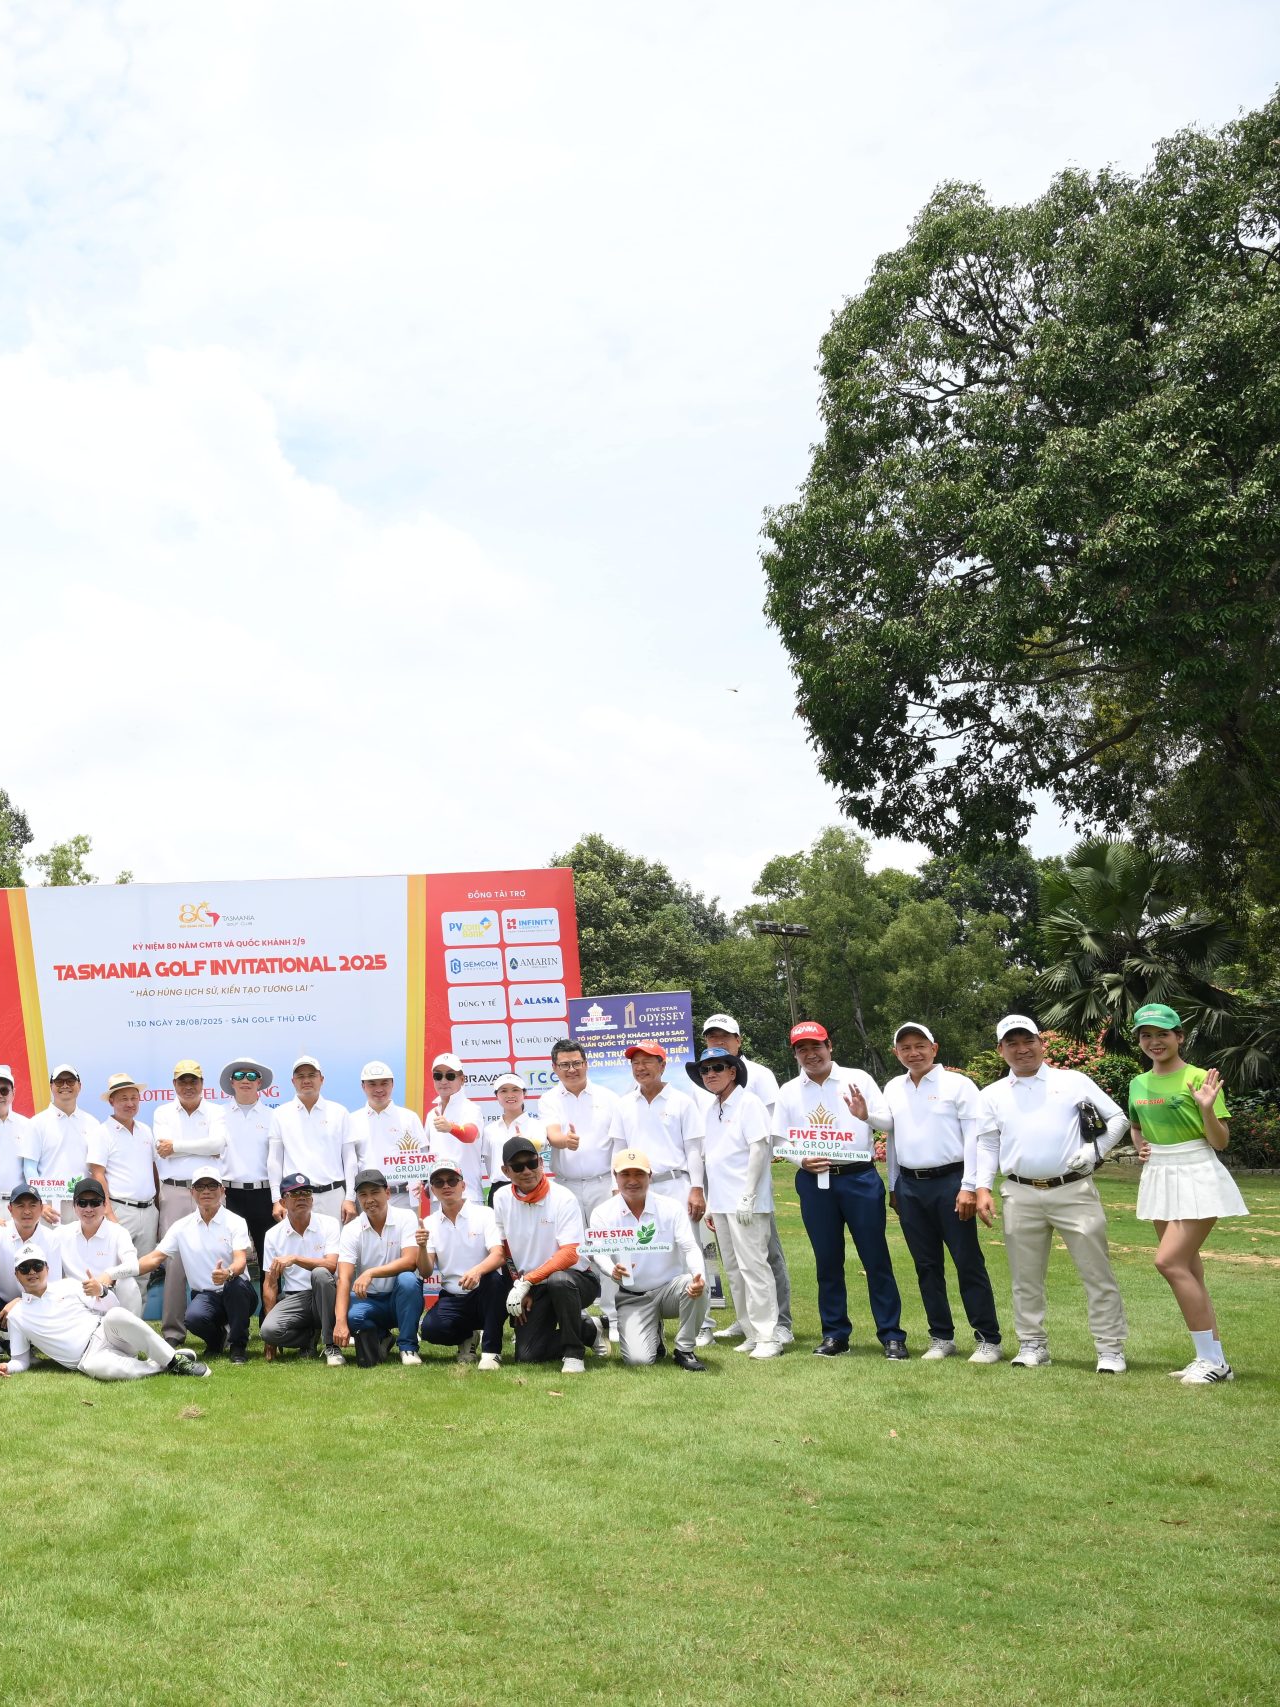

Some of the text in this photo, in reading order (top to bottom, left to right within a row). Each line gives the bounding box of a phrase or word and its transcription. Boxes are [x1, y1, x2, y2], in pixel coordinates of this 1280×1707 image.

[467, 889, 526, 899] ĐỒNG TÀI TRỢ
[518, 918, 554, 926] INFINITY
[145, 941, 165, 952] NIỆM
[178, 941, 198, 949] NĂM
[199, 941, 222, 949] CMT8
[224, 939, 235, 948] VÀ
[236, 937, 260, 948] QUỐC
[261, 937, 291, 947] KHÁNH
[292, 938, 306, 946] 2/9
[463, 960, 498, 968] GEMCOM
[520, 957, 558, 967] AMARIN
[53, 954, 388, 981] TASMANIA GOLF INVITATIONAL 2025
[157, 987, 183, 997] HÙNG
[184, 988, 204, 997] LỊCH
[221, 984, 241, 995] KIẾN
[242, 986, 261, 996] TẠO
[263, 984, 294, 993] TƯƠNG
[295, 984, 308, 993] LAI
[458, 1000, 480, 1008] DŨNG
[488, 998, 497, 1007] TẾ
[523, 996, 560, 1005] ALASKA
[127, 1014, 317, 1028] 11:30 NGÀY 28/08/2025 SÂN GOLF THỦ ĐỨC
[639, 1011, 686, 1023] ODYSSEY
[617, 1033, 626, 1041] HỘ
[461, 1038, 470, 1047] LÊ
[597, 1039, 616, 1047] QUỐC
[617, 1038, 626, 1046] TẾ
[670, 1043, 689, 1054] BIỂN
[789, 1129, 853, 1141] FIVE STAR
[802, 1141, 841, 1150] GROUP
[383, 1156, 406, 1166] FIVE
[409, 1154, 436, 1164] STAR
[395, 1165, 426, 1173] GROUP
[588, 1229, 634, 1239] FIVE STAR
